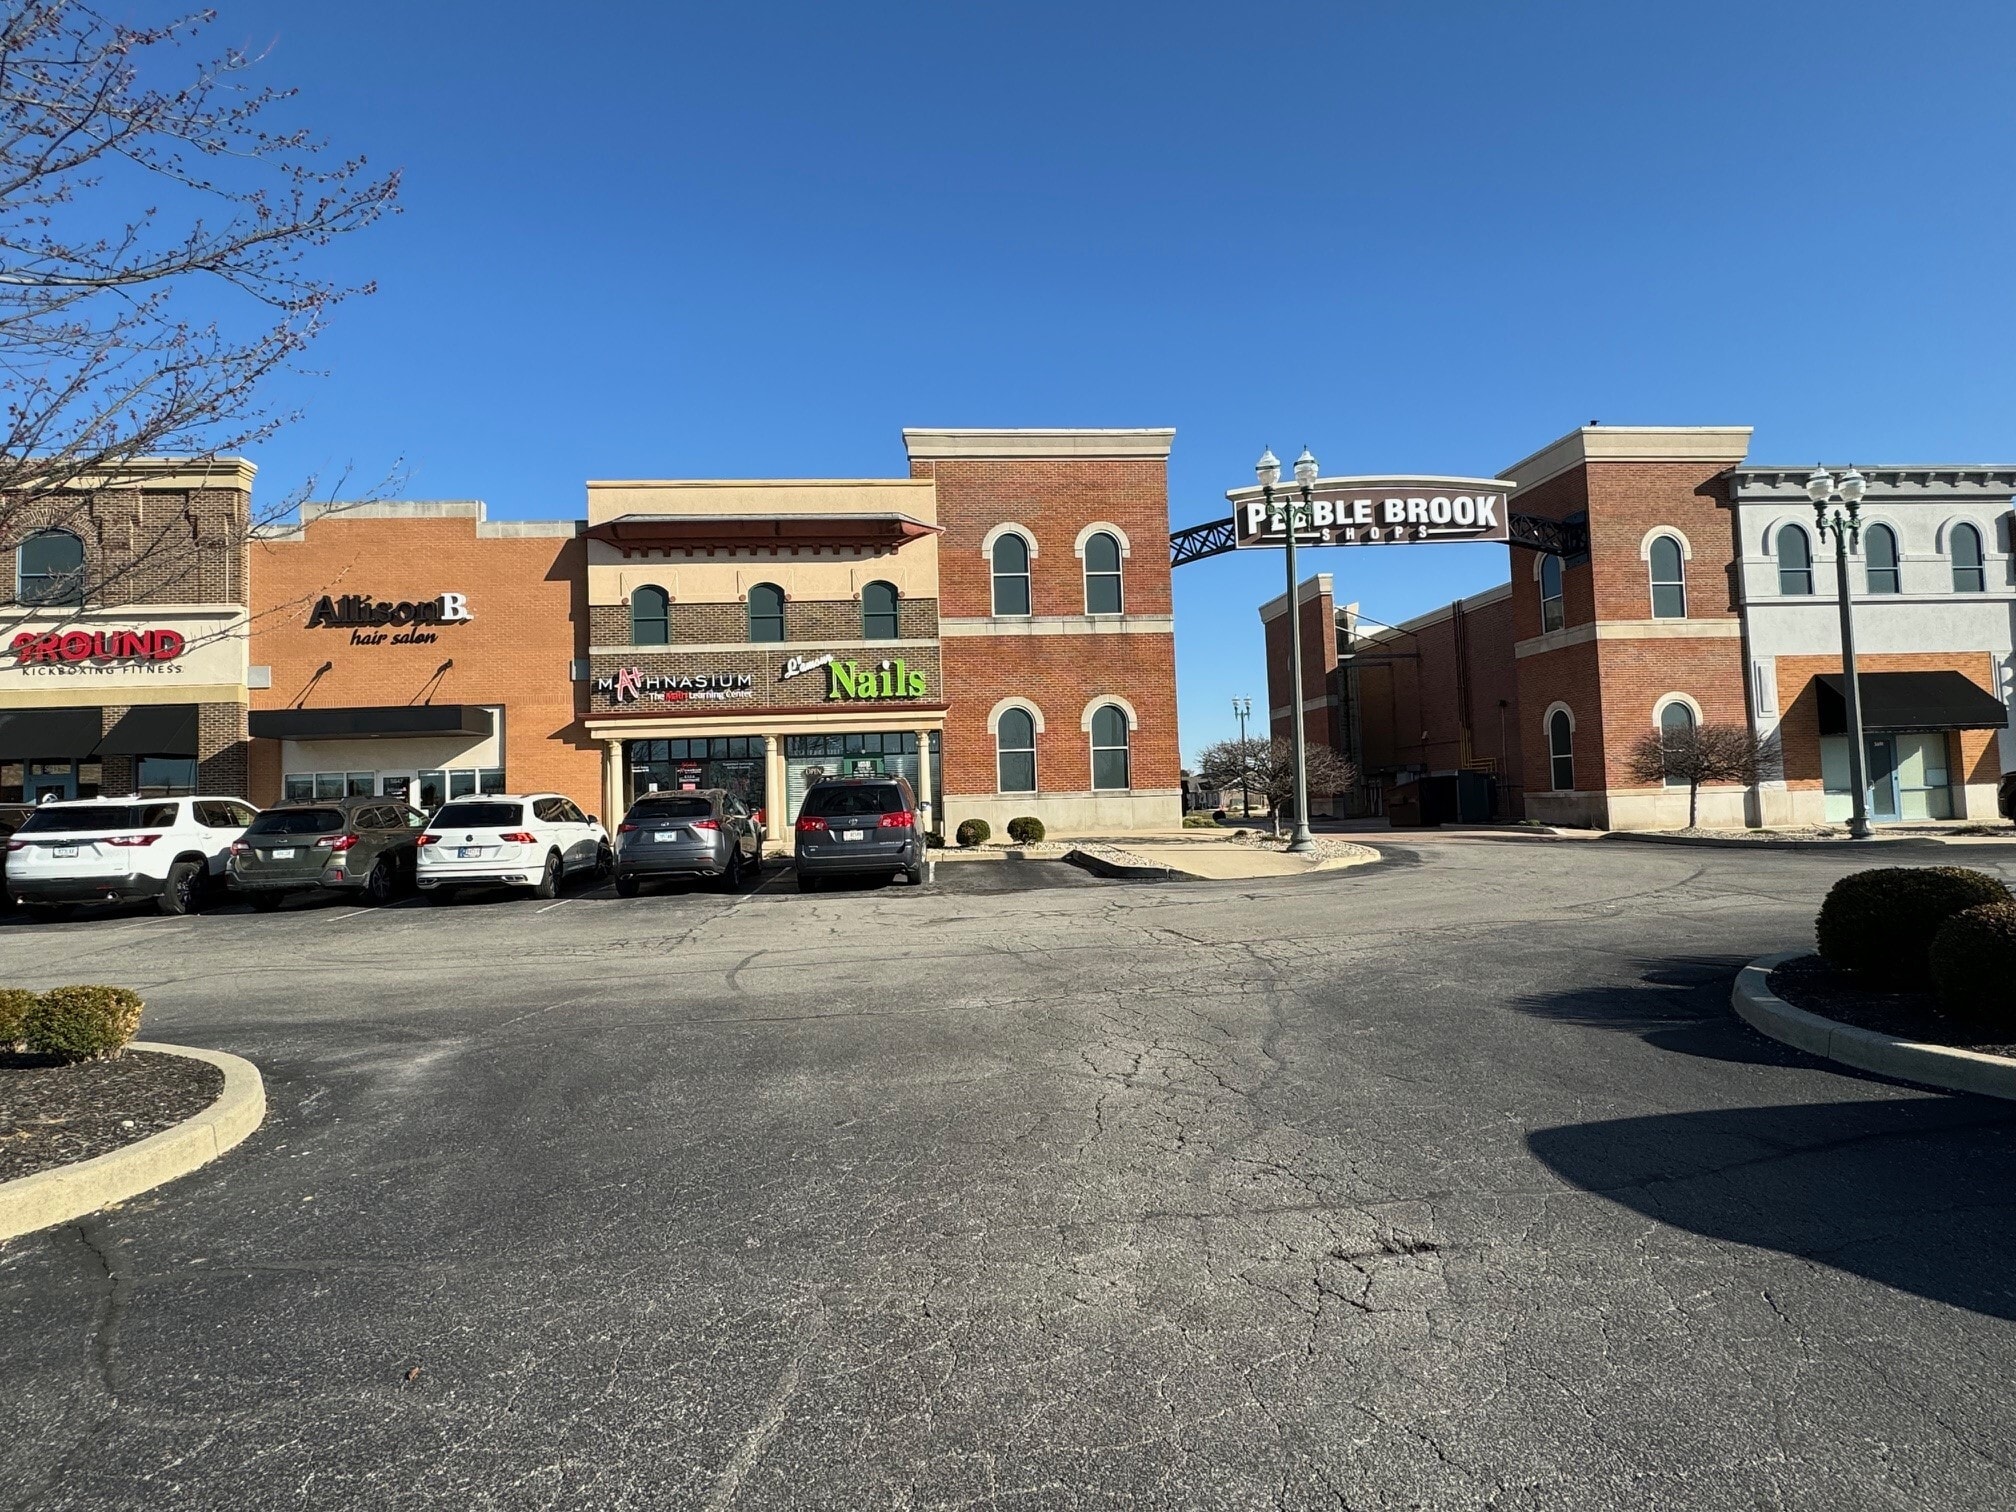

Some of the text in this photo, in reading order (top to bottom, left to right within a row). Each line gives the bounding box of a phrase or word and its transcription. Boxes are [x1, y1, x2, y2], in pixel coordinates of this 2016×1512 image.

[1247, 496, 1498, 534] PEBBLE BROOK
[1321, 525, 1428, 541] SHOPS
[350, 626, 439, 646] hair salon
[22, 664, 183, 676] KICKBOXING FITNESS
[829, 658, 926, 698] Nails
[649, 689, 752, 701] The Math Learning Center
